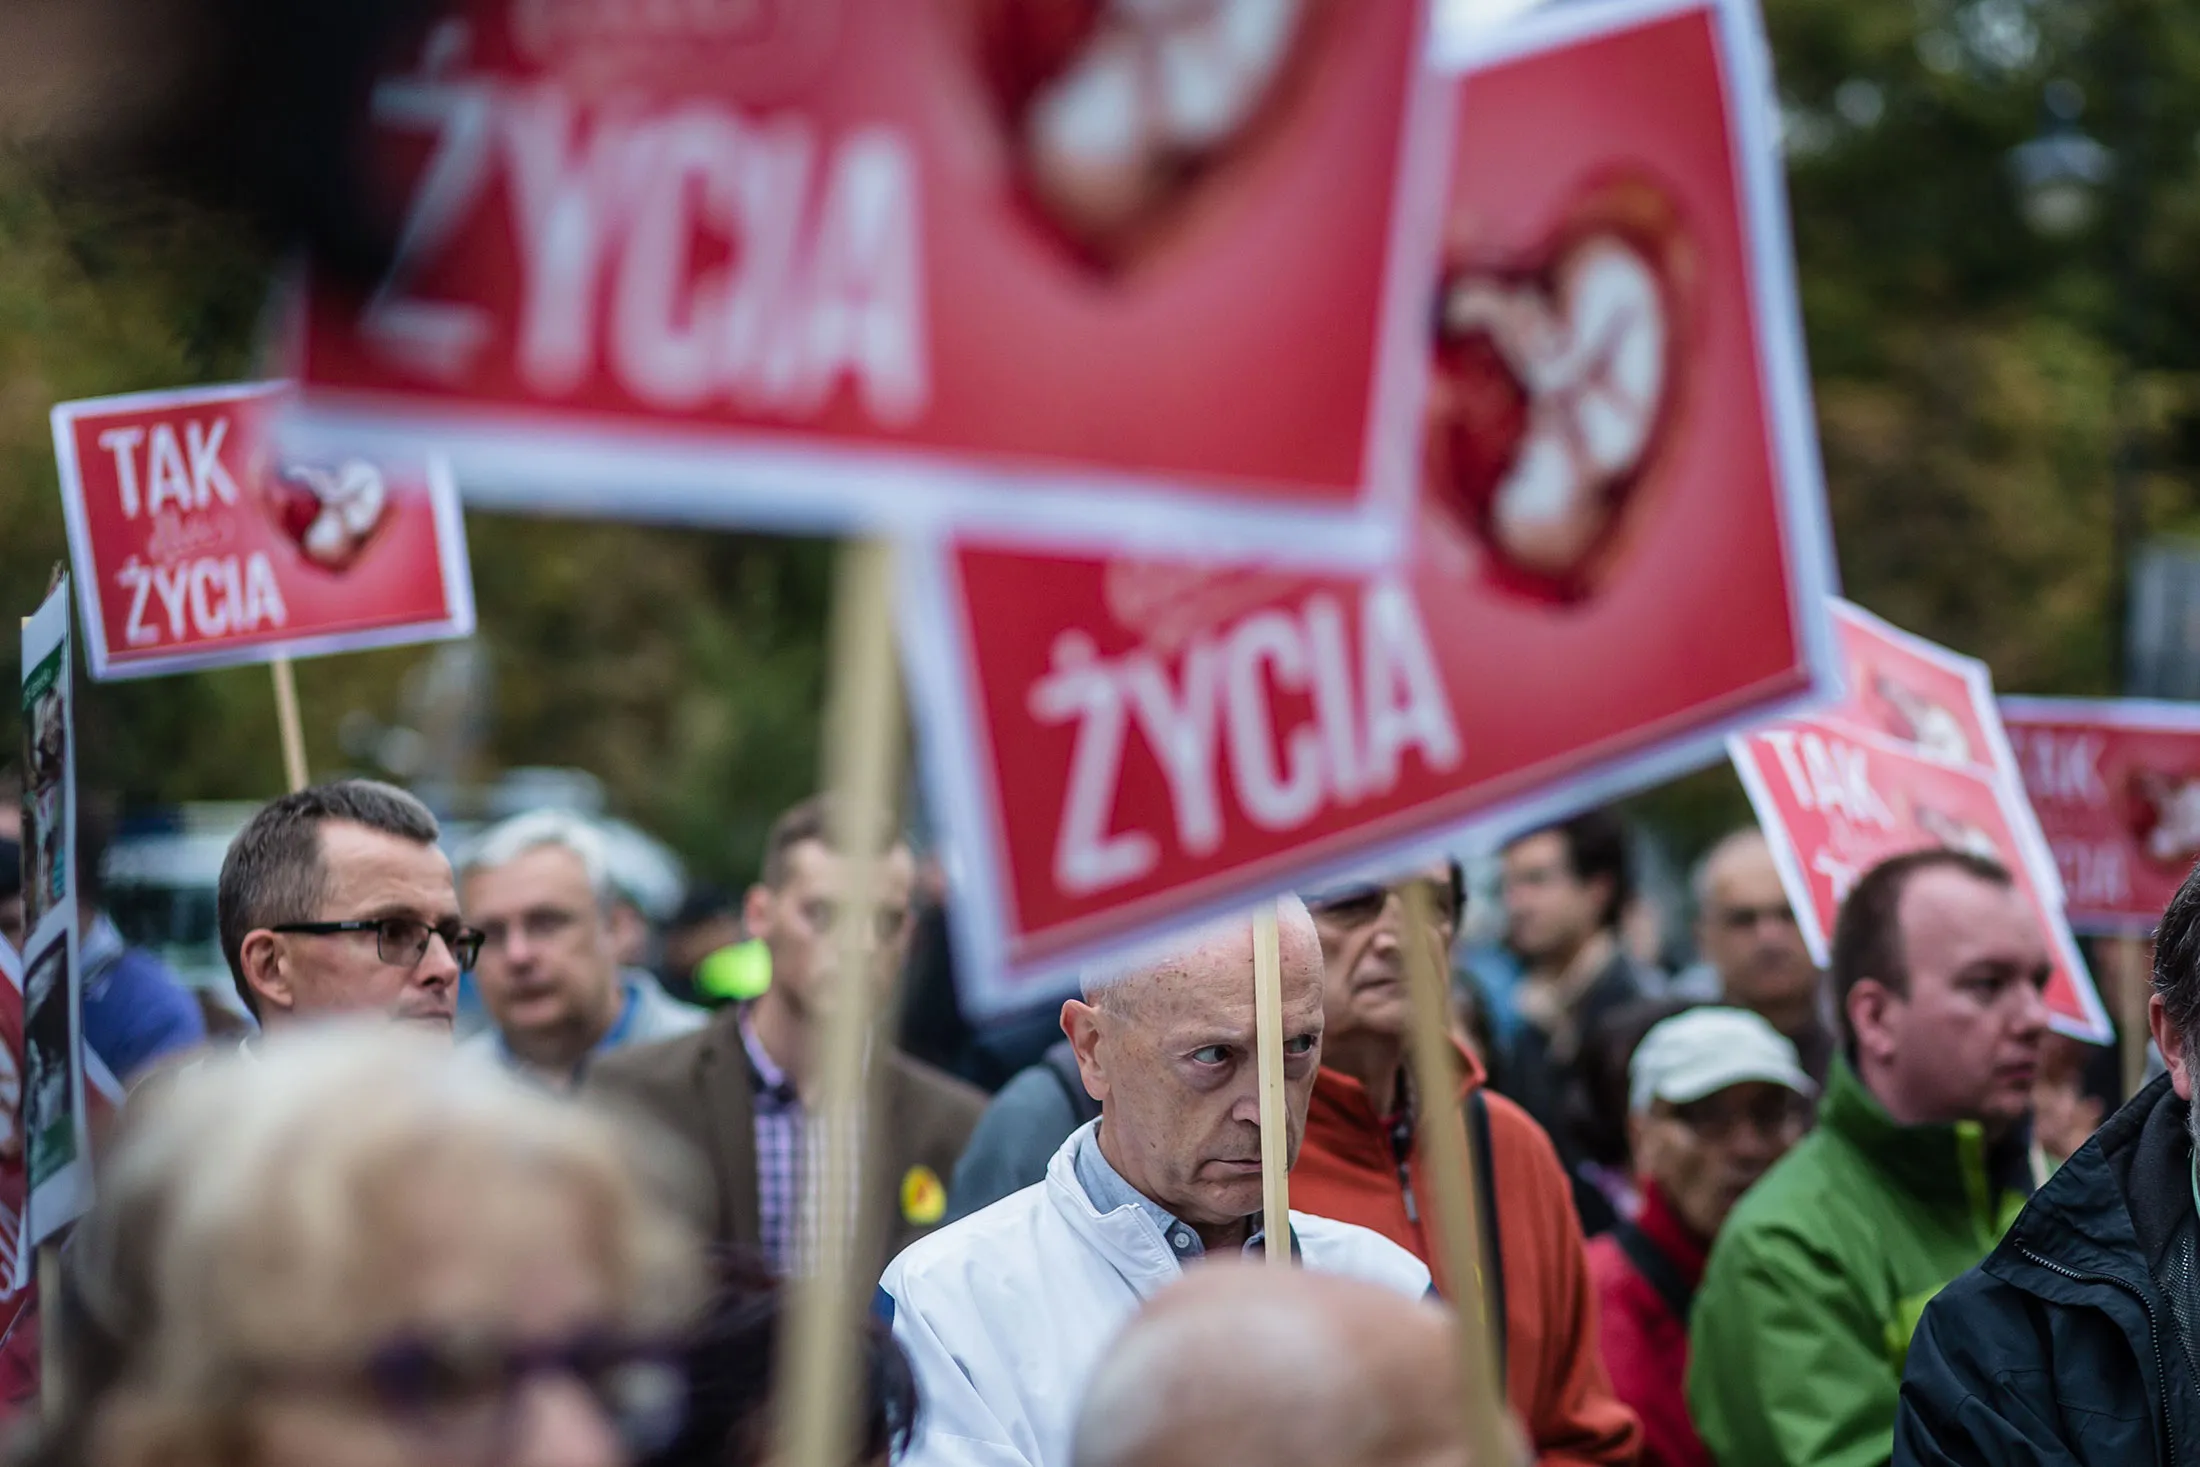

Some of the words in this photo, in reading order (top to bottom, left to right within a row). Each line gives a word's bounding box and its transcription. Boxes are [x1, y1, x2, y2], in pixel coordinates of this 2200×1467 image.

[360, 18, 926, 420] ŻYCIA
[98, 416, 238, 518] TAK
[117, 552, 287, 646] ŻYCIA
[1028, 583, 1464, 892] ŻYCIA
[1756, 729, 1896, 832] TAK
